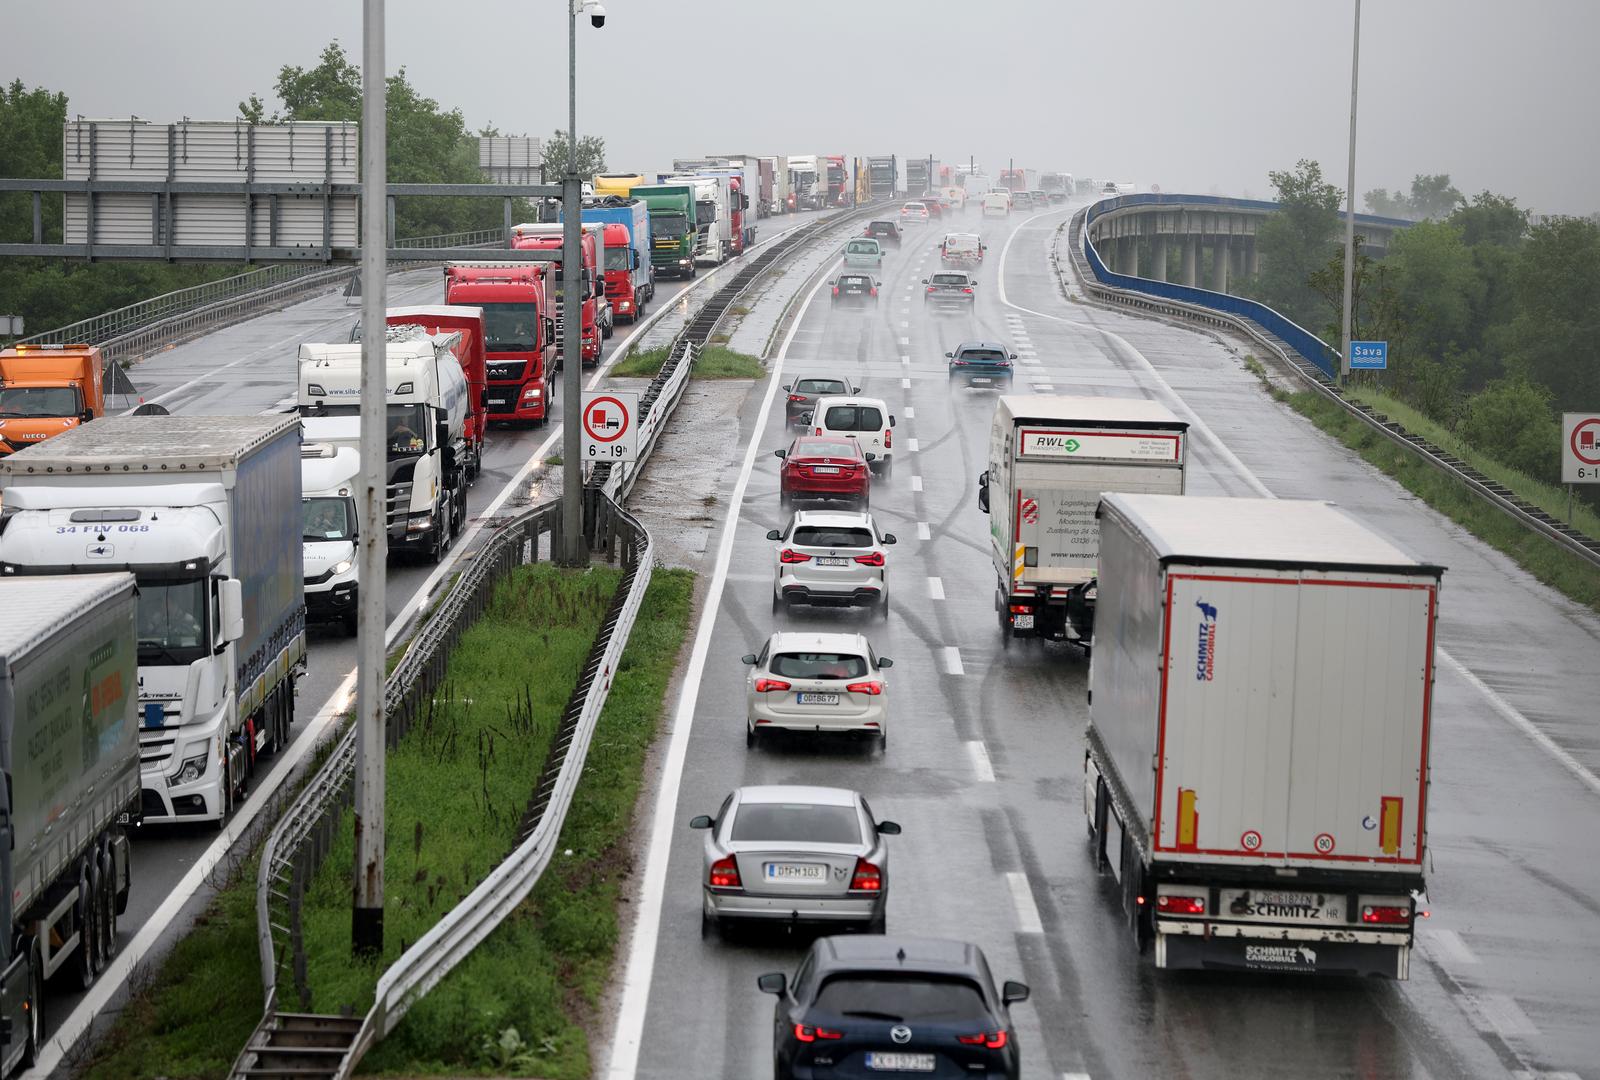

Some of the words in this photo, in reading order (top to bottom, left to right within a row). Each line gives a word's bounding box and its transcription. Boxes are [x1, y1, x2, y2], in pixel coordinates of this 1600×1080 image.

[1355, 346, 1382, 356] Sava
[1037, 437, 1064, 447] RWL
[589, 445, 596, 456] 6
[56, 526, 77, 534] 34
[83, 525, 112, 533] FLV
[1047, 527, 1079, 535] Zustellung
[1197, 623, 1208, 681] SCHMITZ
[1206, 624, 1216, 681] CARGOBULL
[1246, 836, 1257, 846] 80
[1319, 839, 1330, 849] 90
[1247, 904, 1320, 919] SCHMITZ
[1326, 909, 1339, 918] HR
[1246, 945, 1297, 957] SCHMITZ
[1246, 954, 1296, 963] CARGOBULL
